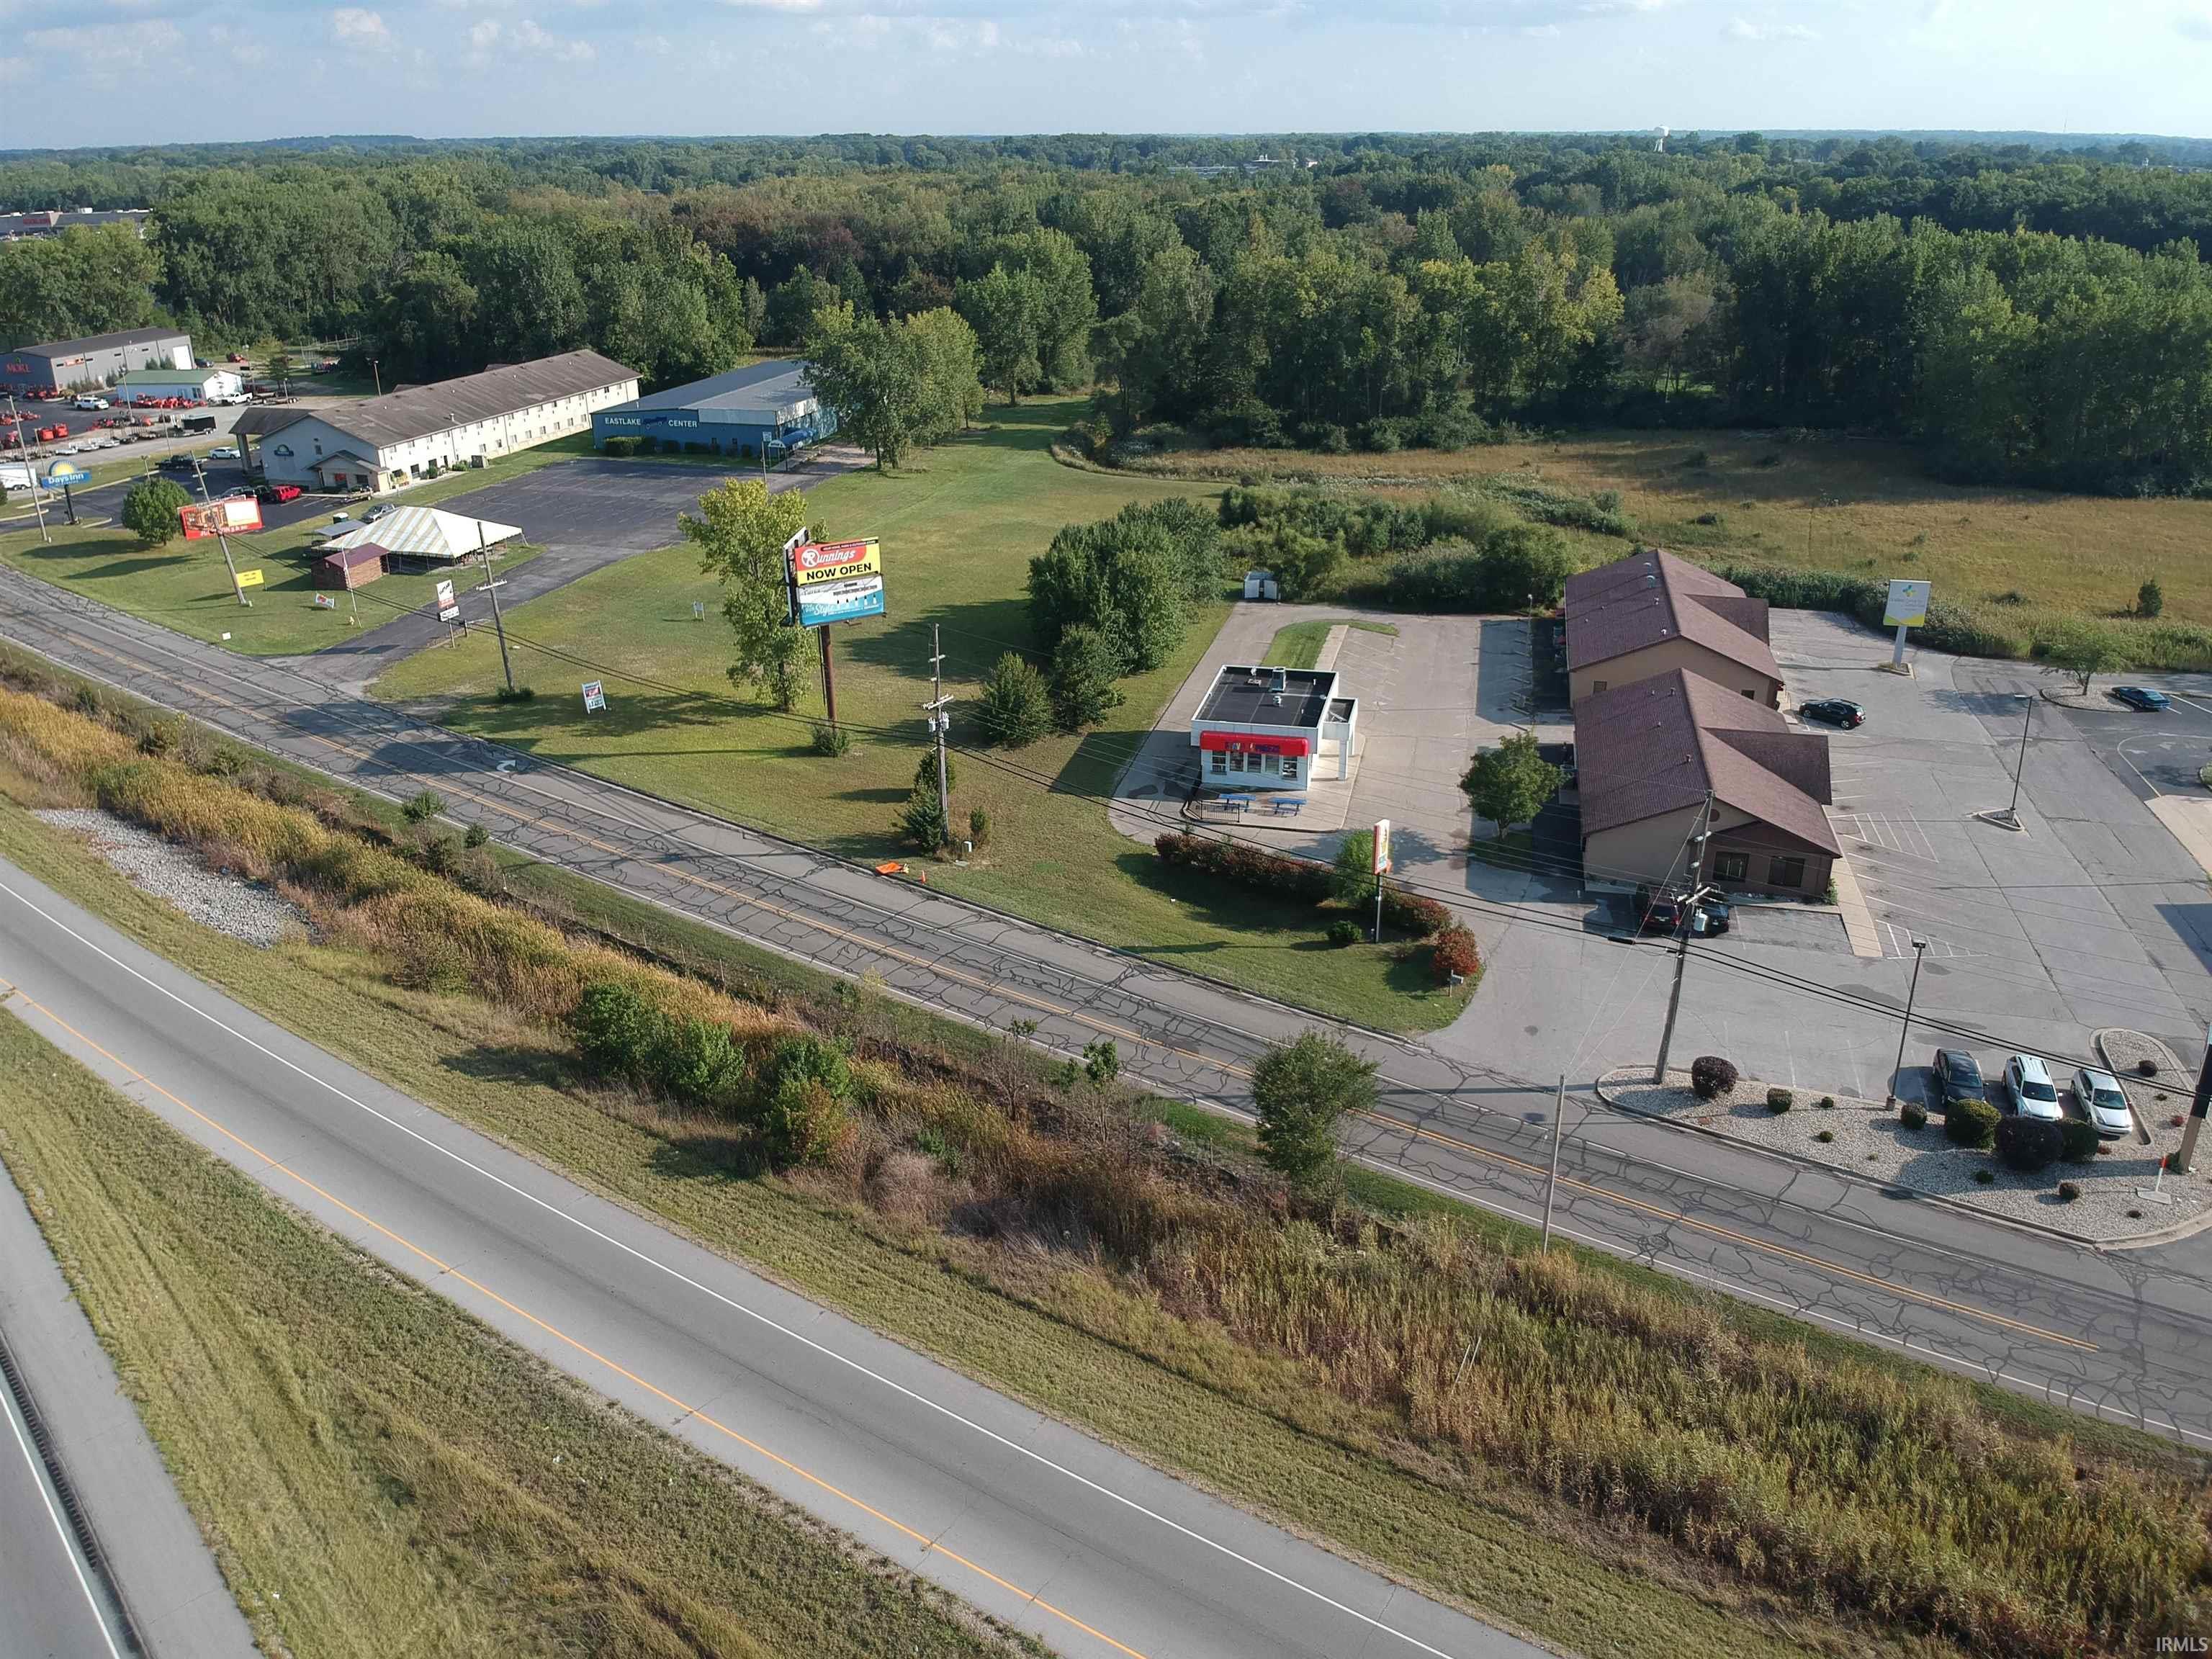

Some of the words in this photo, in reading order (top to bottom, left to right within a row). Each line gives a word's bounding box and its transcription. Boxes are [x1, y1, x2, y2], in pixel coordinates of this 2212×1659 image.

[605, 417, 642, 426] EASTLAKE
[48, 475, 69, 485] Days
[801, 549, 855, 567] Runnings
[806, 567, 837, 581] NOW
[840, 562, 872, 576] OPEN
